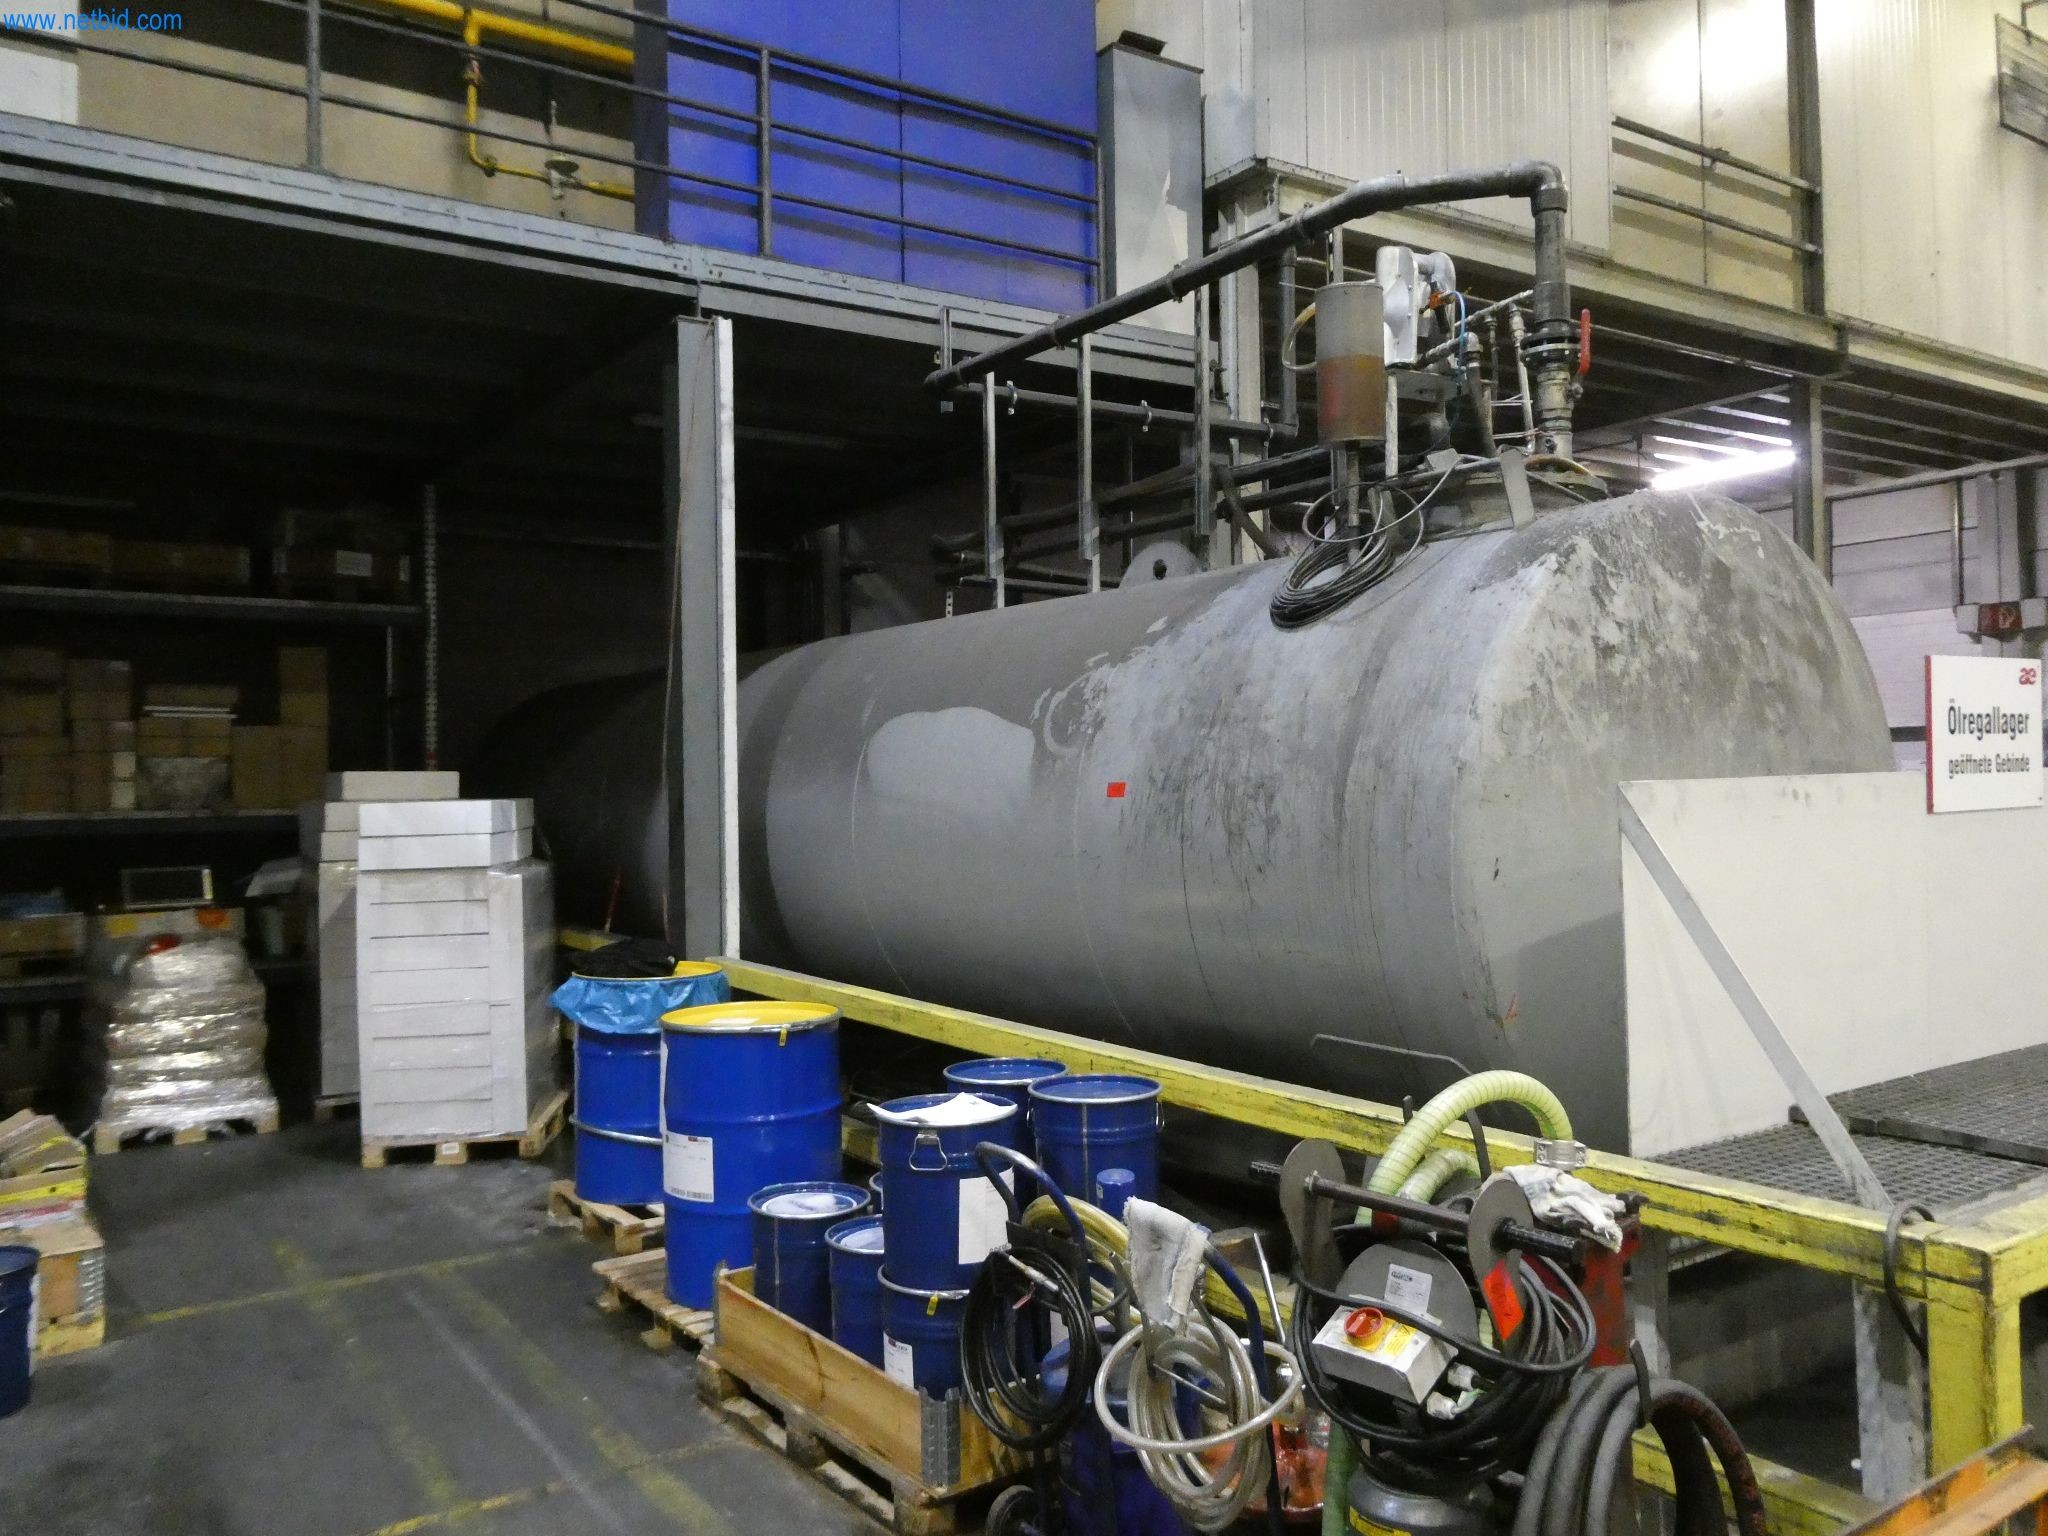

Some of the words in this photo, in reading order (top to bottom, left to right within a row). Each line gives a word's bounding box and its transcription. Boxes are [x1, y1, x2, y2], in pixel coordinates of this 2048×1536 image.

[1948, 698, 2030, 741] Ölregallager
[1949, 753, 1992, 780] geöffnete
[1995, 752, 2031, 773] Gebinde
